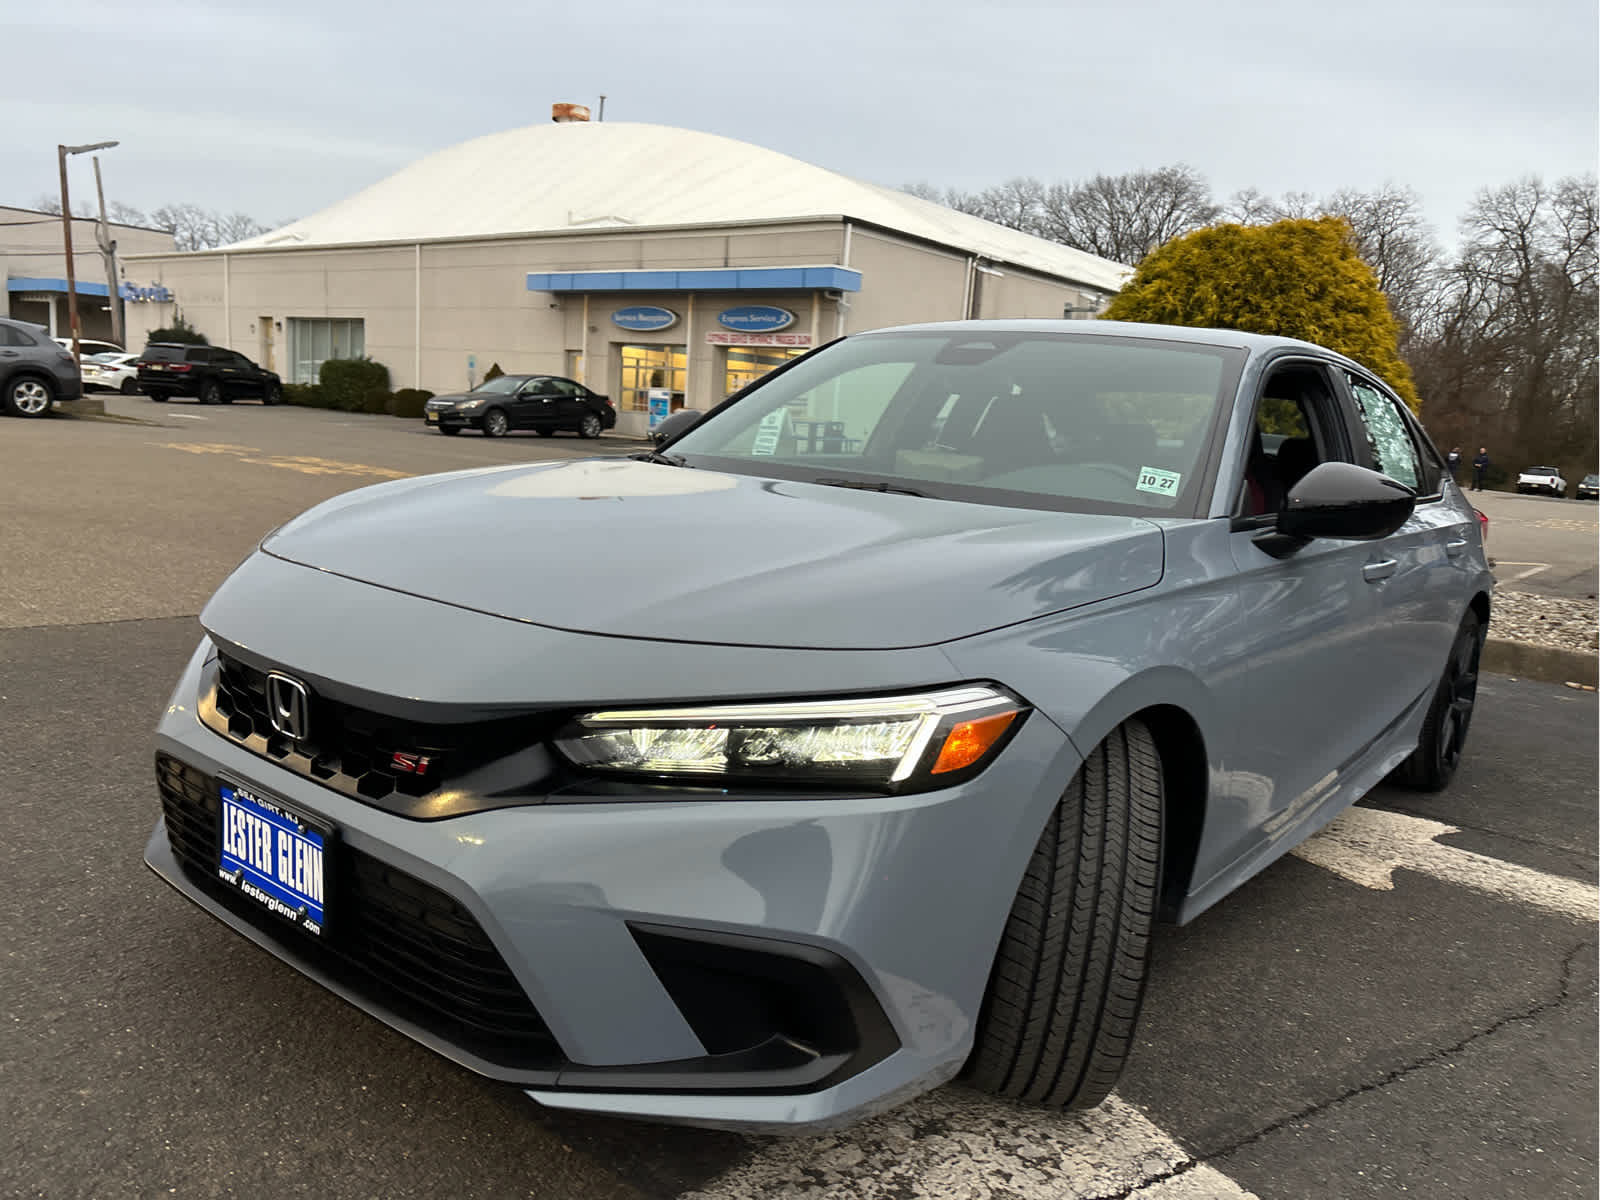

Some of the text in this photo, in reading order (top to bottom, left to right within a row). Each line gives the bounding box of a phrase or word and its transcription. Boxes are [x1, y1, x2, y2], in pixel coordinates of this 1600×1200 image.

[1140, 475, 1175, 489] 10 27
[223, 801, 324, 905] LESTER GLENN
